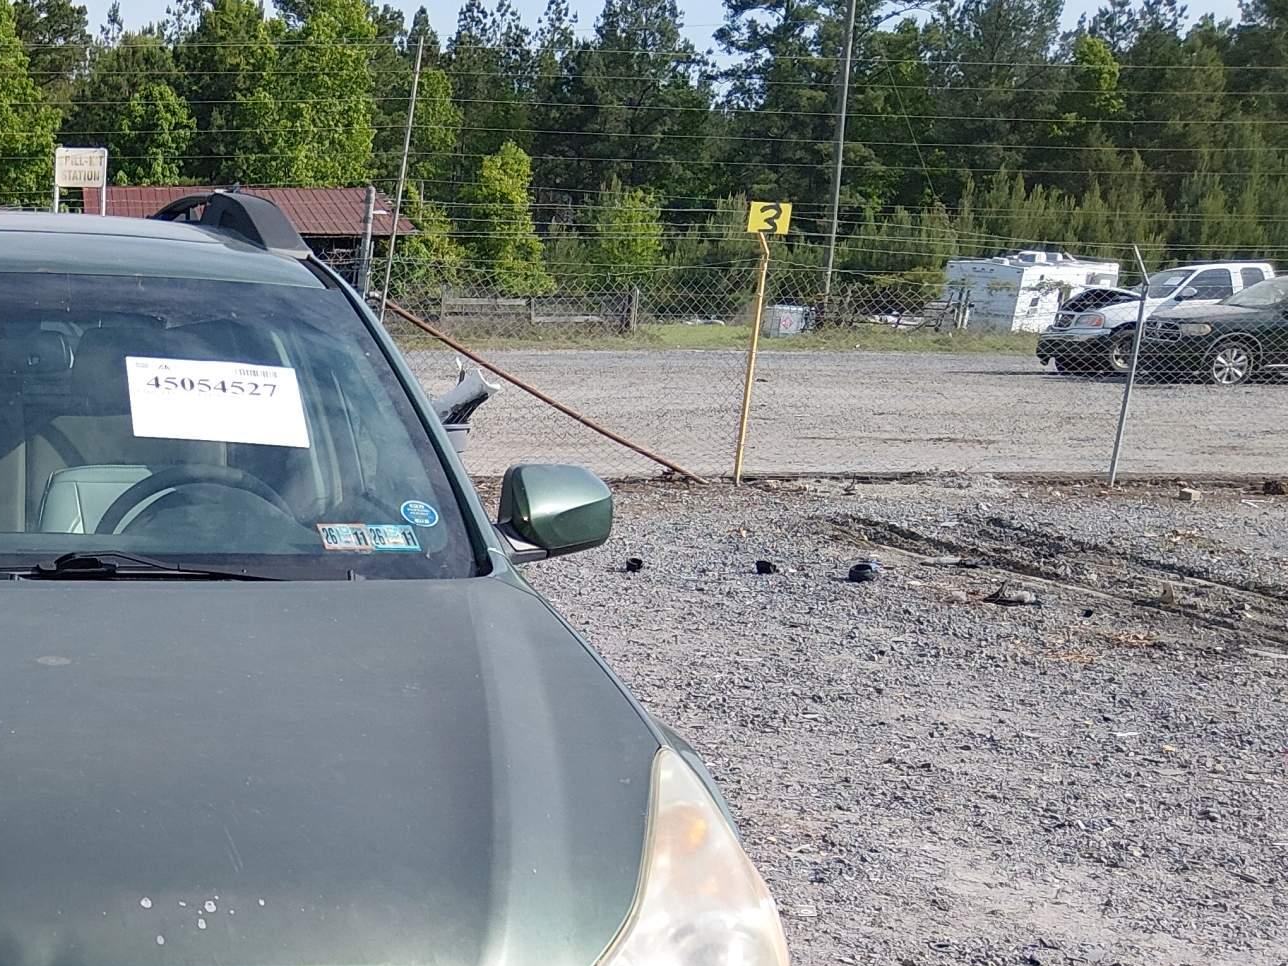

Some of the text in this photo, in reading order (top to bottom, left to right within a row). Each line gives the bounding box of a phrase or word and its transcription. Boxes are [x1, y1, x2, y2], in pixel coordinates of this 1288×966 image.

[758, 204, 783, 233] 3
[146, 375, 277, 397] 45054527
[353, 530, 369, 546] 11
[401, 530, 418, 546] 11
